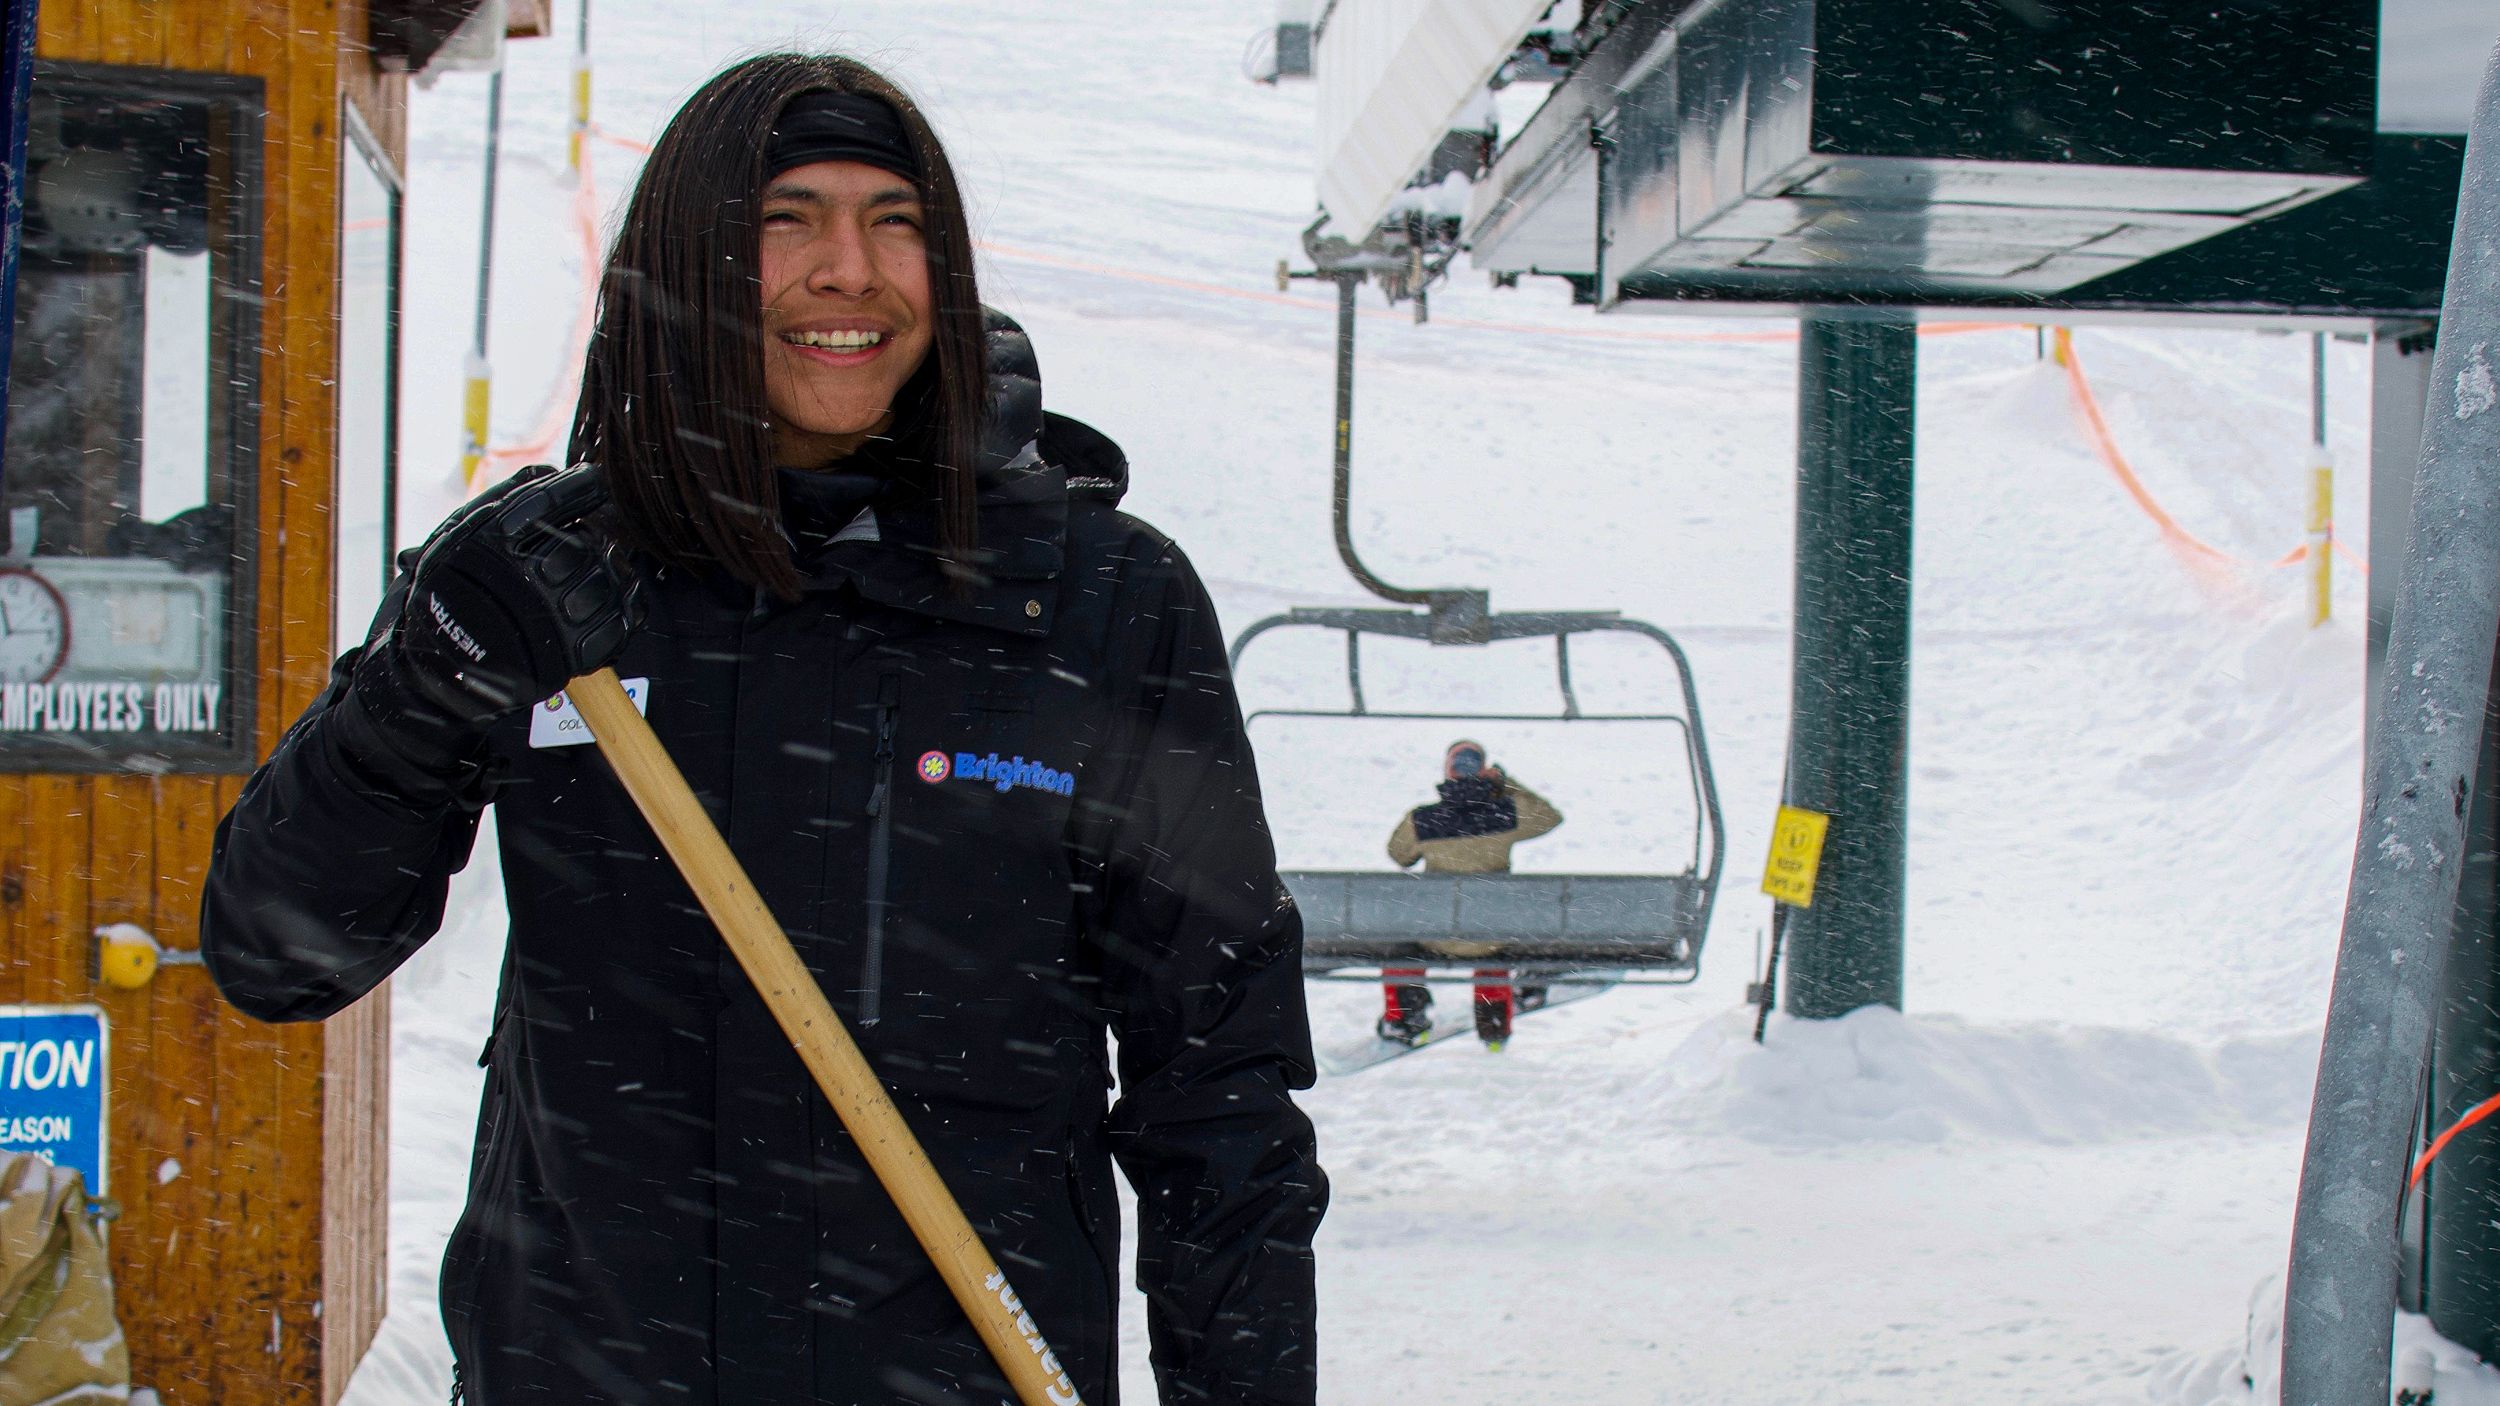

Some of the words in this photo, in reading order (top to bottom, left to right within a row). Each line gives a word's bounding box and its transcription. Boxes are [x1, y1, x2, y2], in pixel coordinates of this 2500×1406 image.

[430, 591, 487, 663] HESTRA
[0, 682, 144, 732] MPLOYEES
[154, 682, 222, 732] ONLY
[558, 718, 588, 731] COL
[953, 751, 1076, 798] Brighton
[983, 1264, 1081, 1406] Garant
